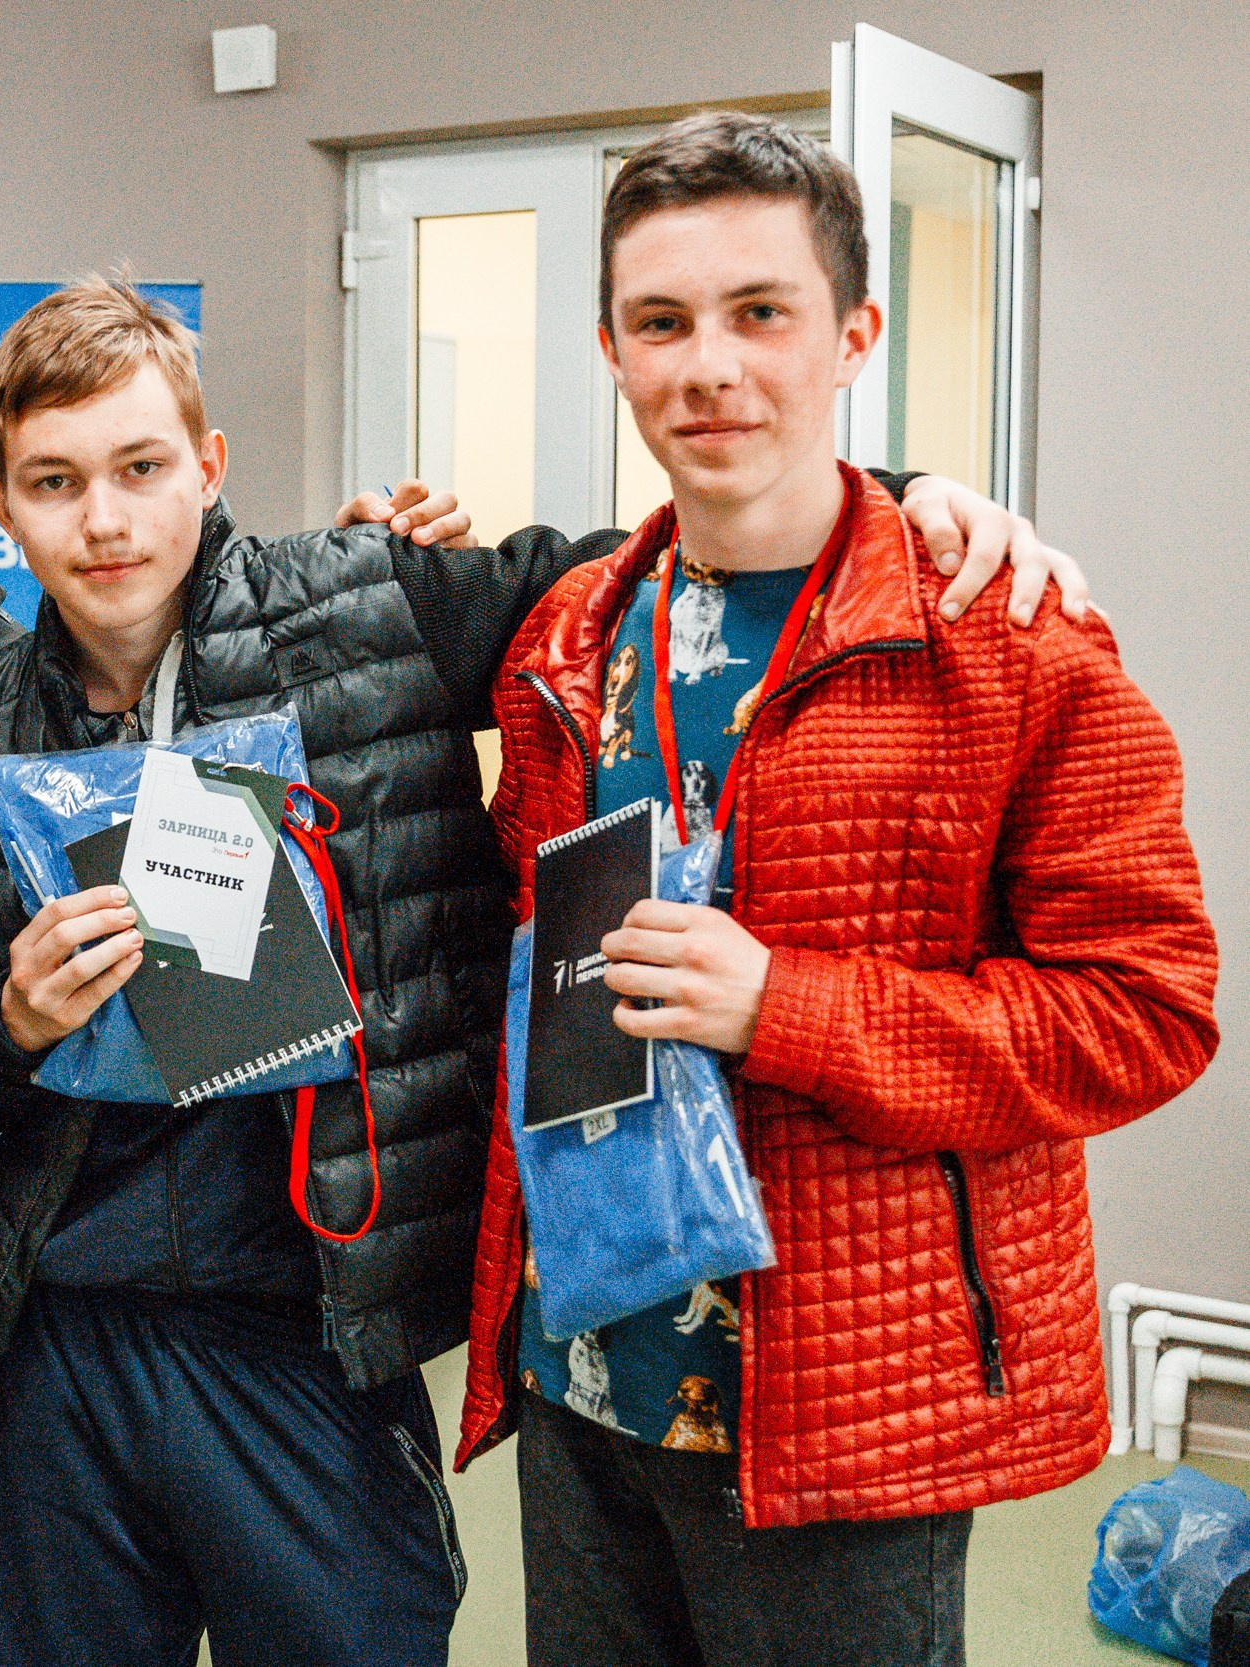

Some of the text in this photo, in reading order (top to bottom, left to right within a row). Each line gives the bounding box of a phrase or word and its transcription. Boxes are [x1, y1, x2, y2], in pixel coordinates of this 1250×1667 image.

[158, 818, 254, 849] ЗАРНИЦА 2.0
[145, 859, 245, 892] УЧАСТНИК
